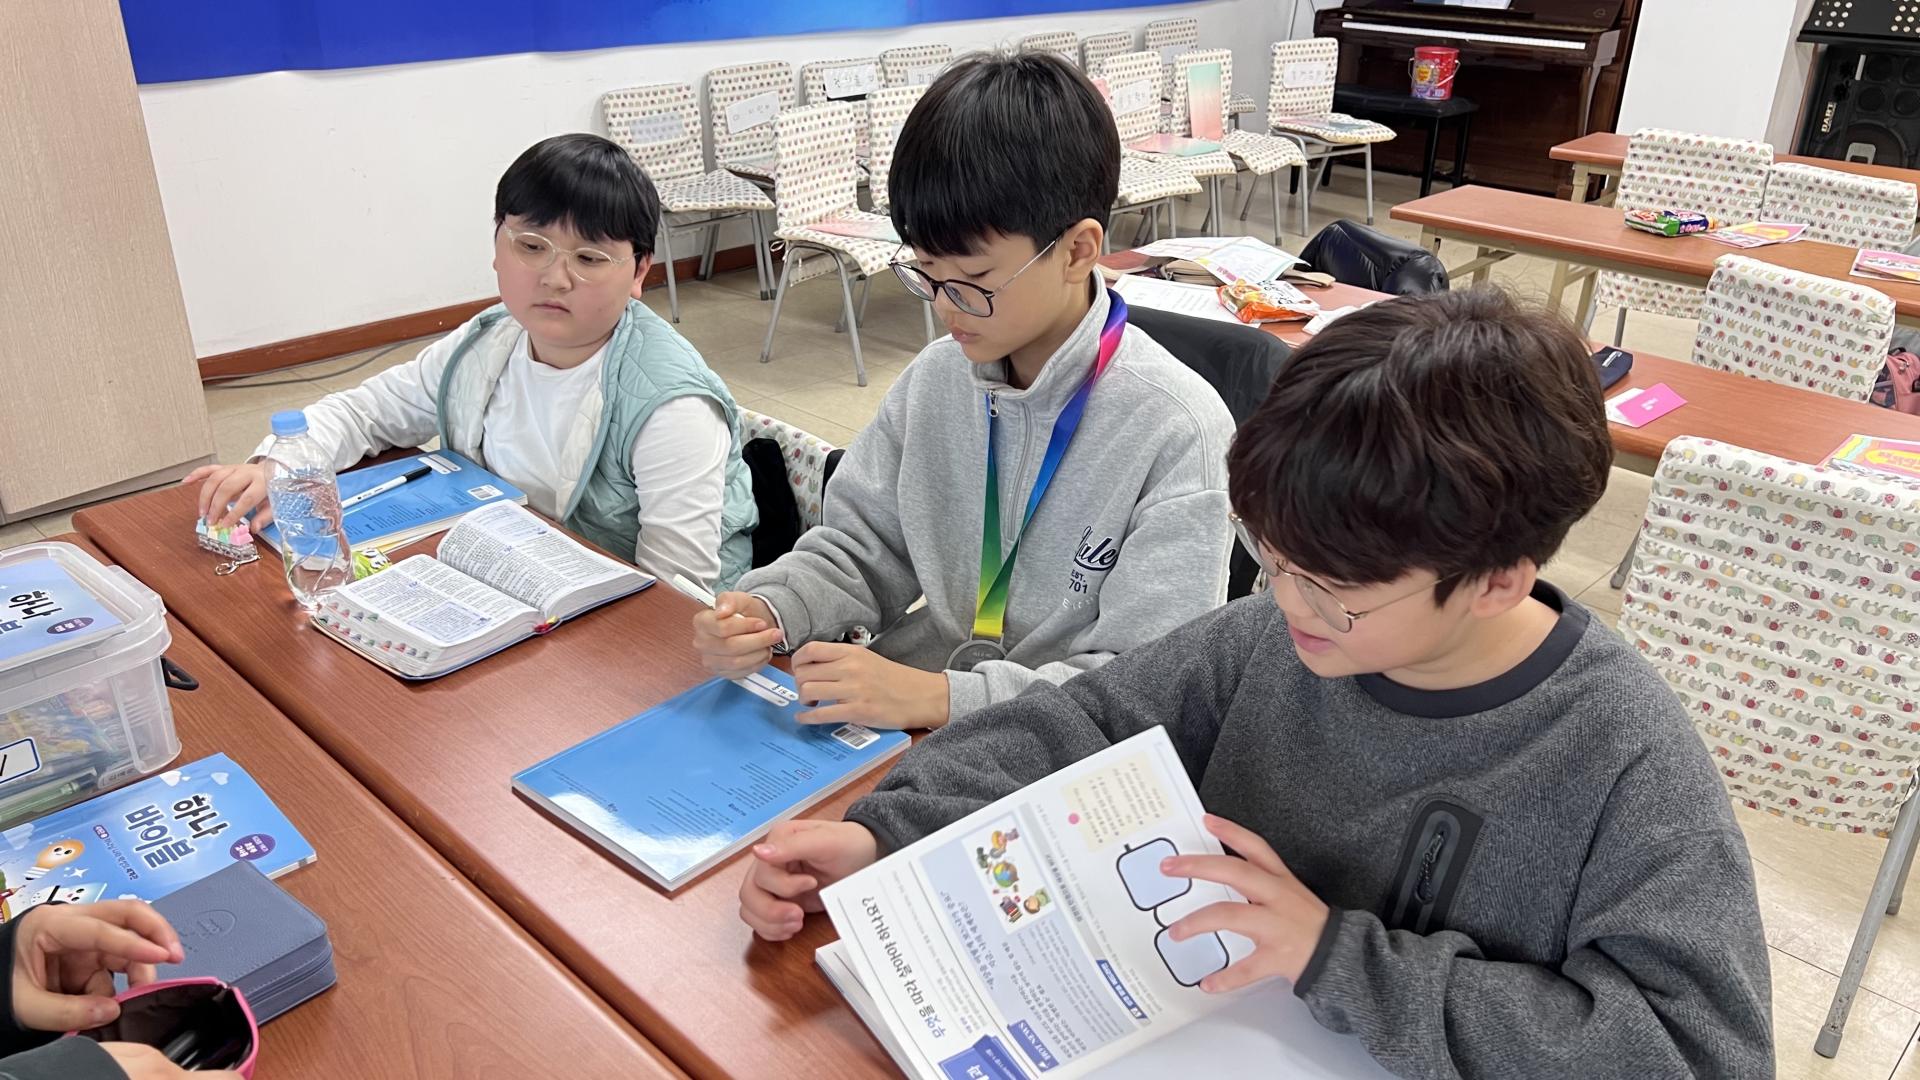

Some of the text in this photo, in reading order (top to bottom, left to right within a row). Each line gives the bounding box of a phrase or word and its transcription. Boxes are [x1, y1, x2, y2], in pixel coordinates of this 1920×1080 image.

[8, 589, 63, 620] 하나
[125, 804, 194, 868] 바이블
[172, 792, 228, 838] 하나
[859, 894, 947, 1040] 무엇을 따라 살아야 하나요?
[1018, 1021, 1051, 1061] HOT NEWS
